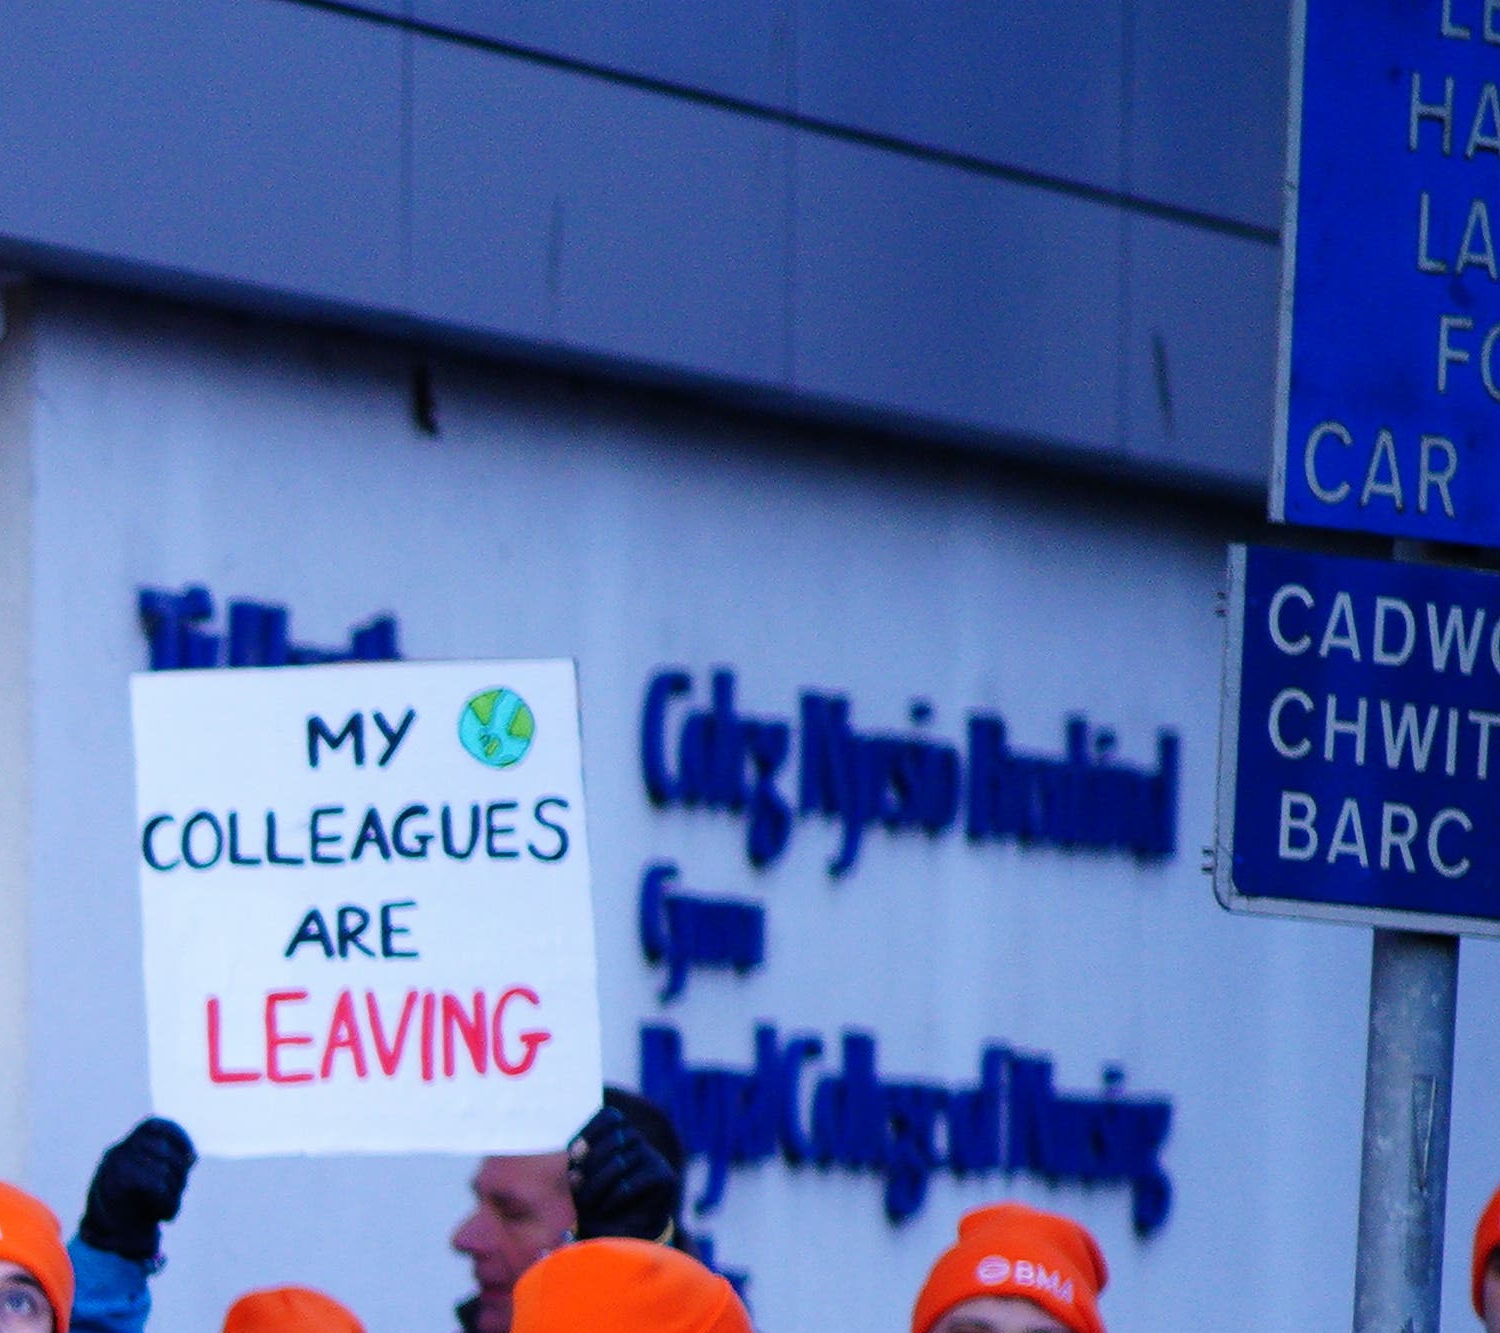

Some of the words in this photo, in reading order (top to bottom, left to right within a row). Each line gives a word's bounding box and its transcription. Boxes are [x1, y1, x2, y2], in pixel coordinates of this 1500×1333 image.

[1304, 421, 1458, 520] CAR
[1267, 584, 1500, 677] CADW
[306, 704, 417, 769] MY
[141, 796, 570, 870] COLLEAGUES
[1277, 790, 1474, 878] BARC
[283, 900, 420, 959] ARE
[205, 987, 552, 1084] LEAVING
[1013, 1264, 1073, 1304] BMA
